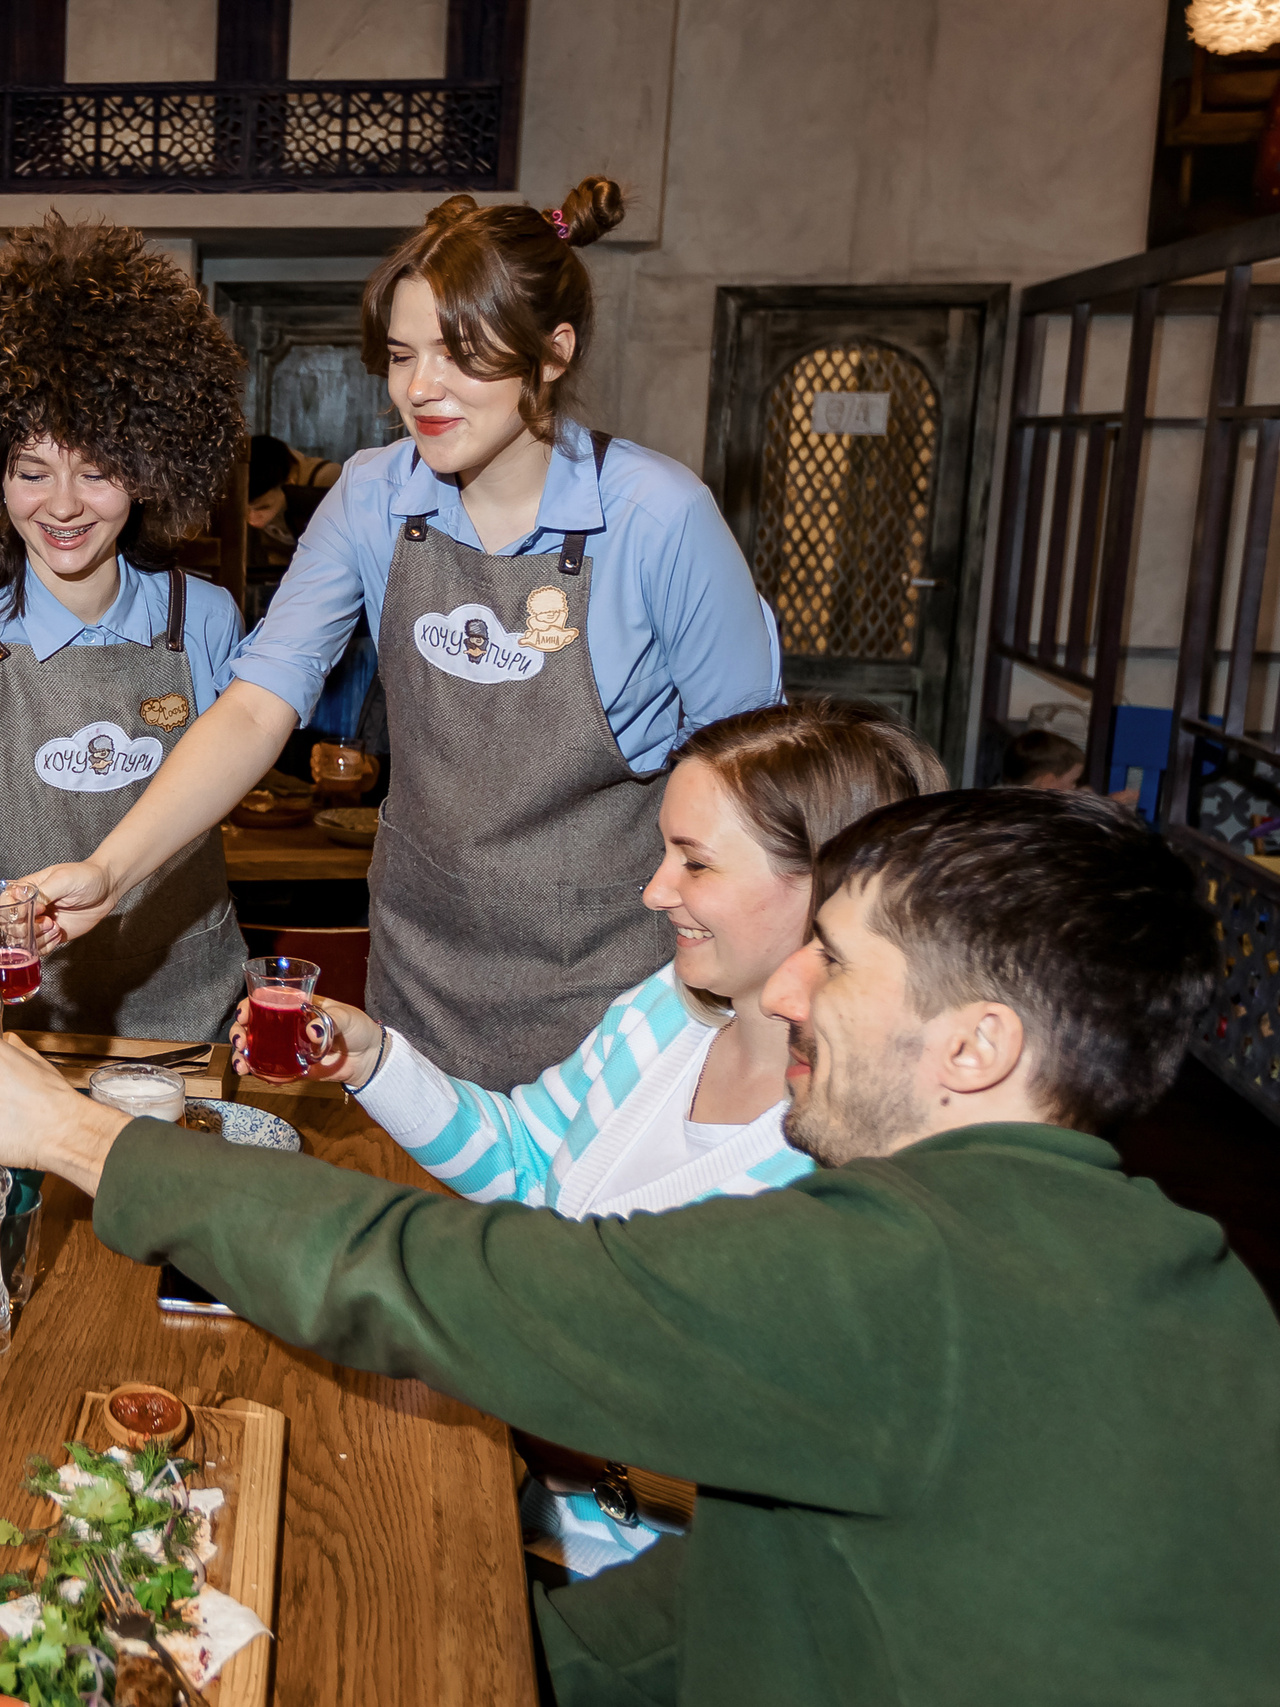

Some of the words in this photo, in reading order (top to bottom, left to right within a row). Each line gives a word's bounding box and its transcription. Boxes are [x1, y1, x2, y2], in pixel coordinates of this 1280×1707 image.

[420, 624, 464, 656] ХОЧУ
[485, 643, 533, 675] ПУРИ
[43, 751, 88, 774] ХОЧУ
[112, 752, 154, 773] ПУРИ
